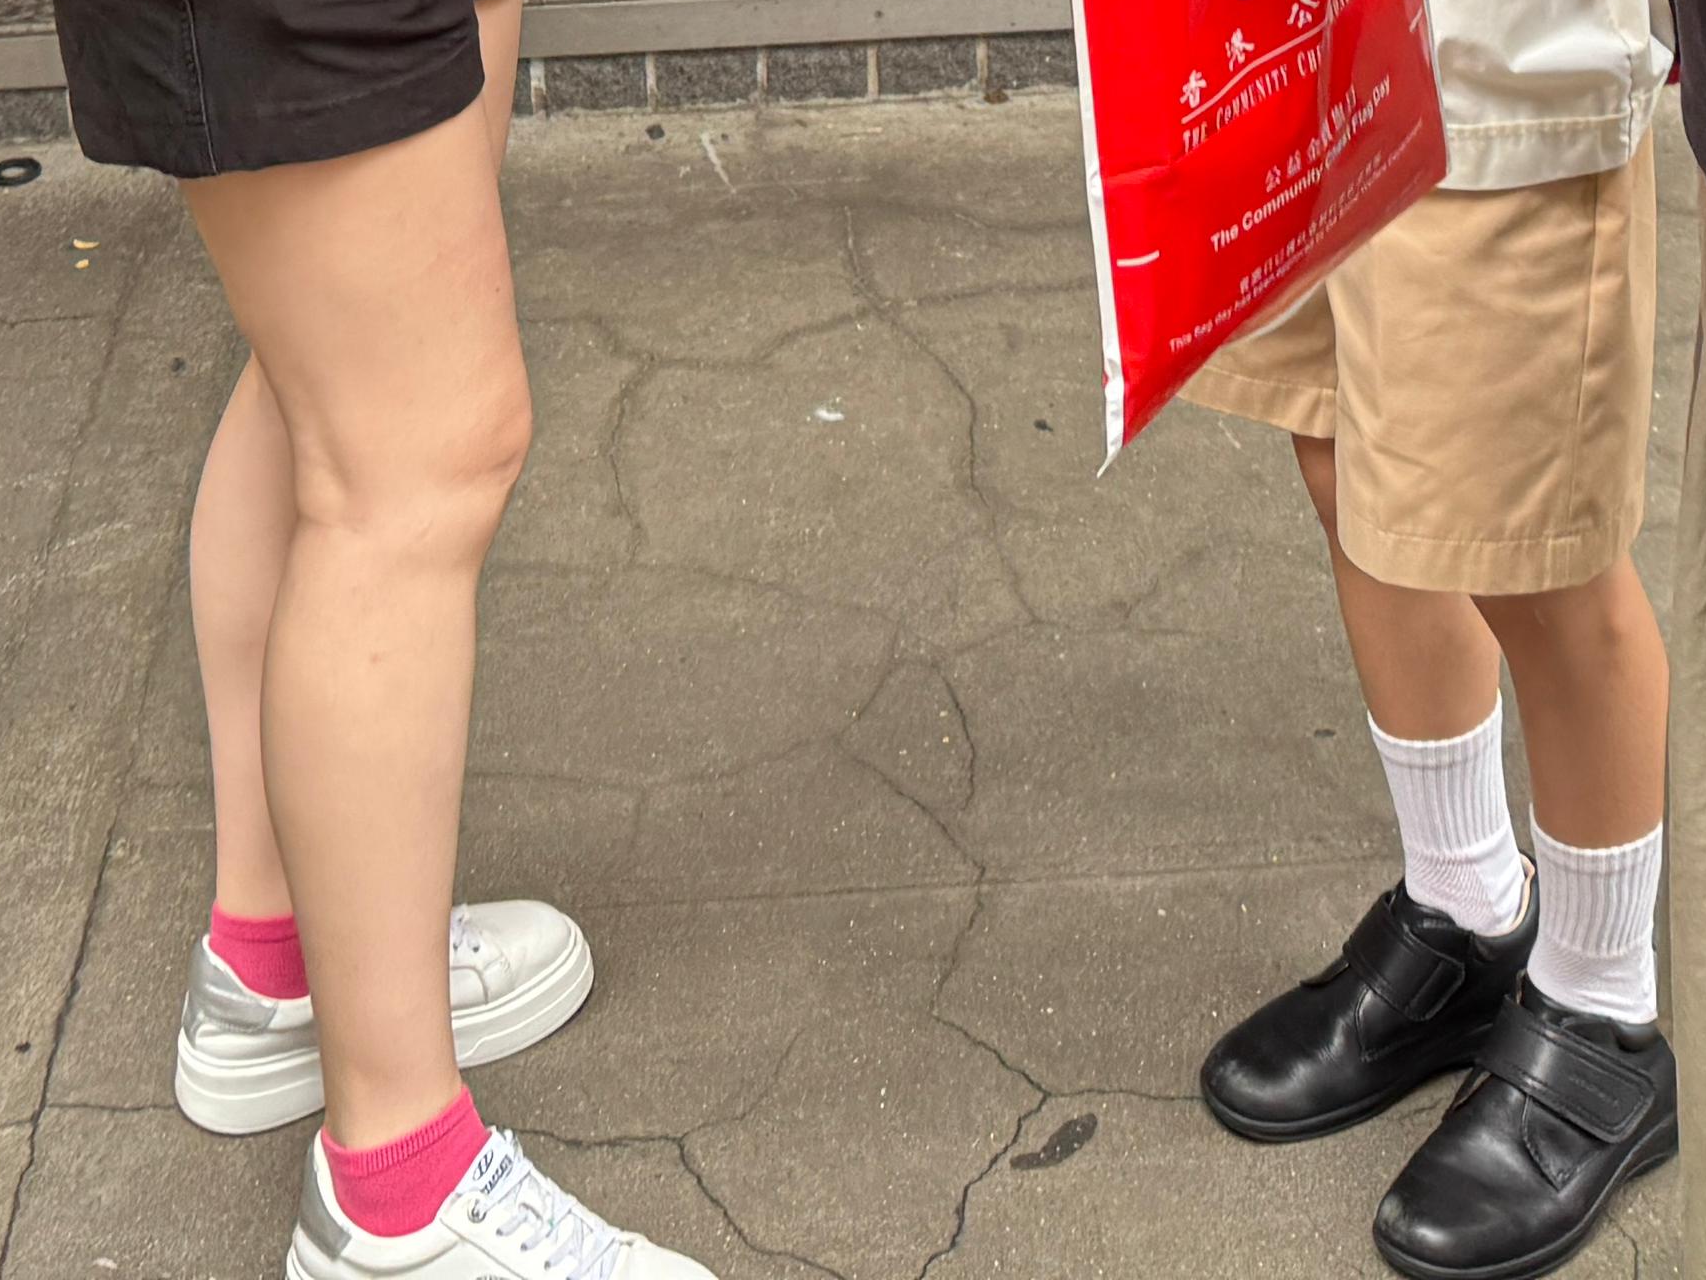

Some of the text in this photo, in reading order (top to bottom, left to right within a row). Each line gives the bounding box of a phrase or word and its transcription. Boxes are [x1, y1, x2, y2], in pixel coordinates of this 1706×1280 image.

[1183, 122, 1208, 154] THE
[1215, 63, 1289, 131] COMMUNITY
[1210, 223, 1239, 253] The
[1242, 162, 1324, 231] Community
[1352, 99, 1374, 134] Flag
[1373, 72, 1390, 107] Day
